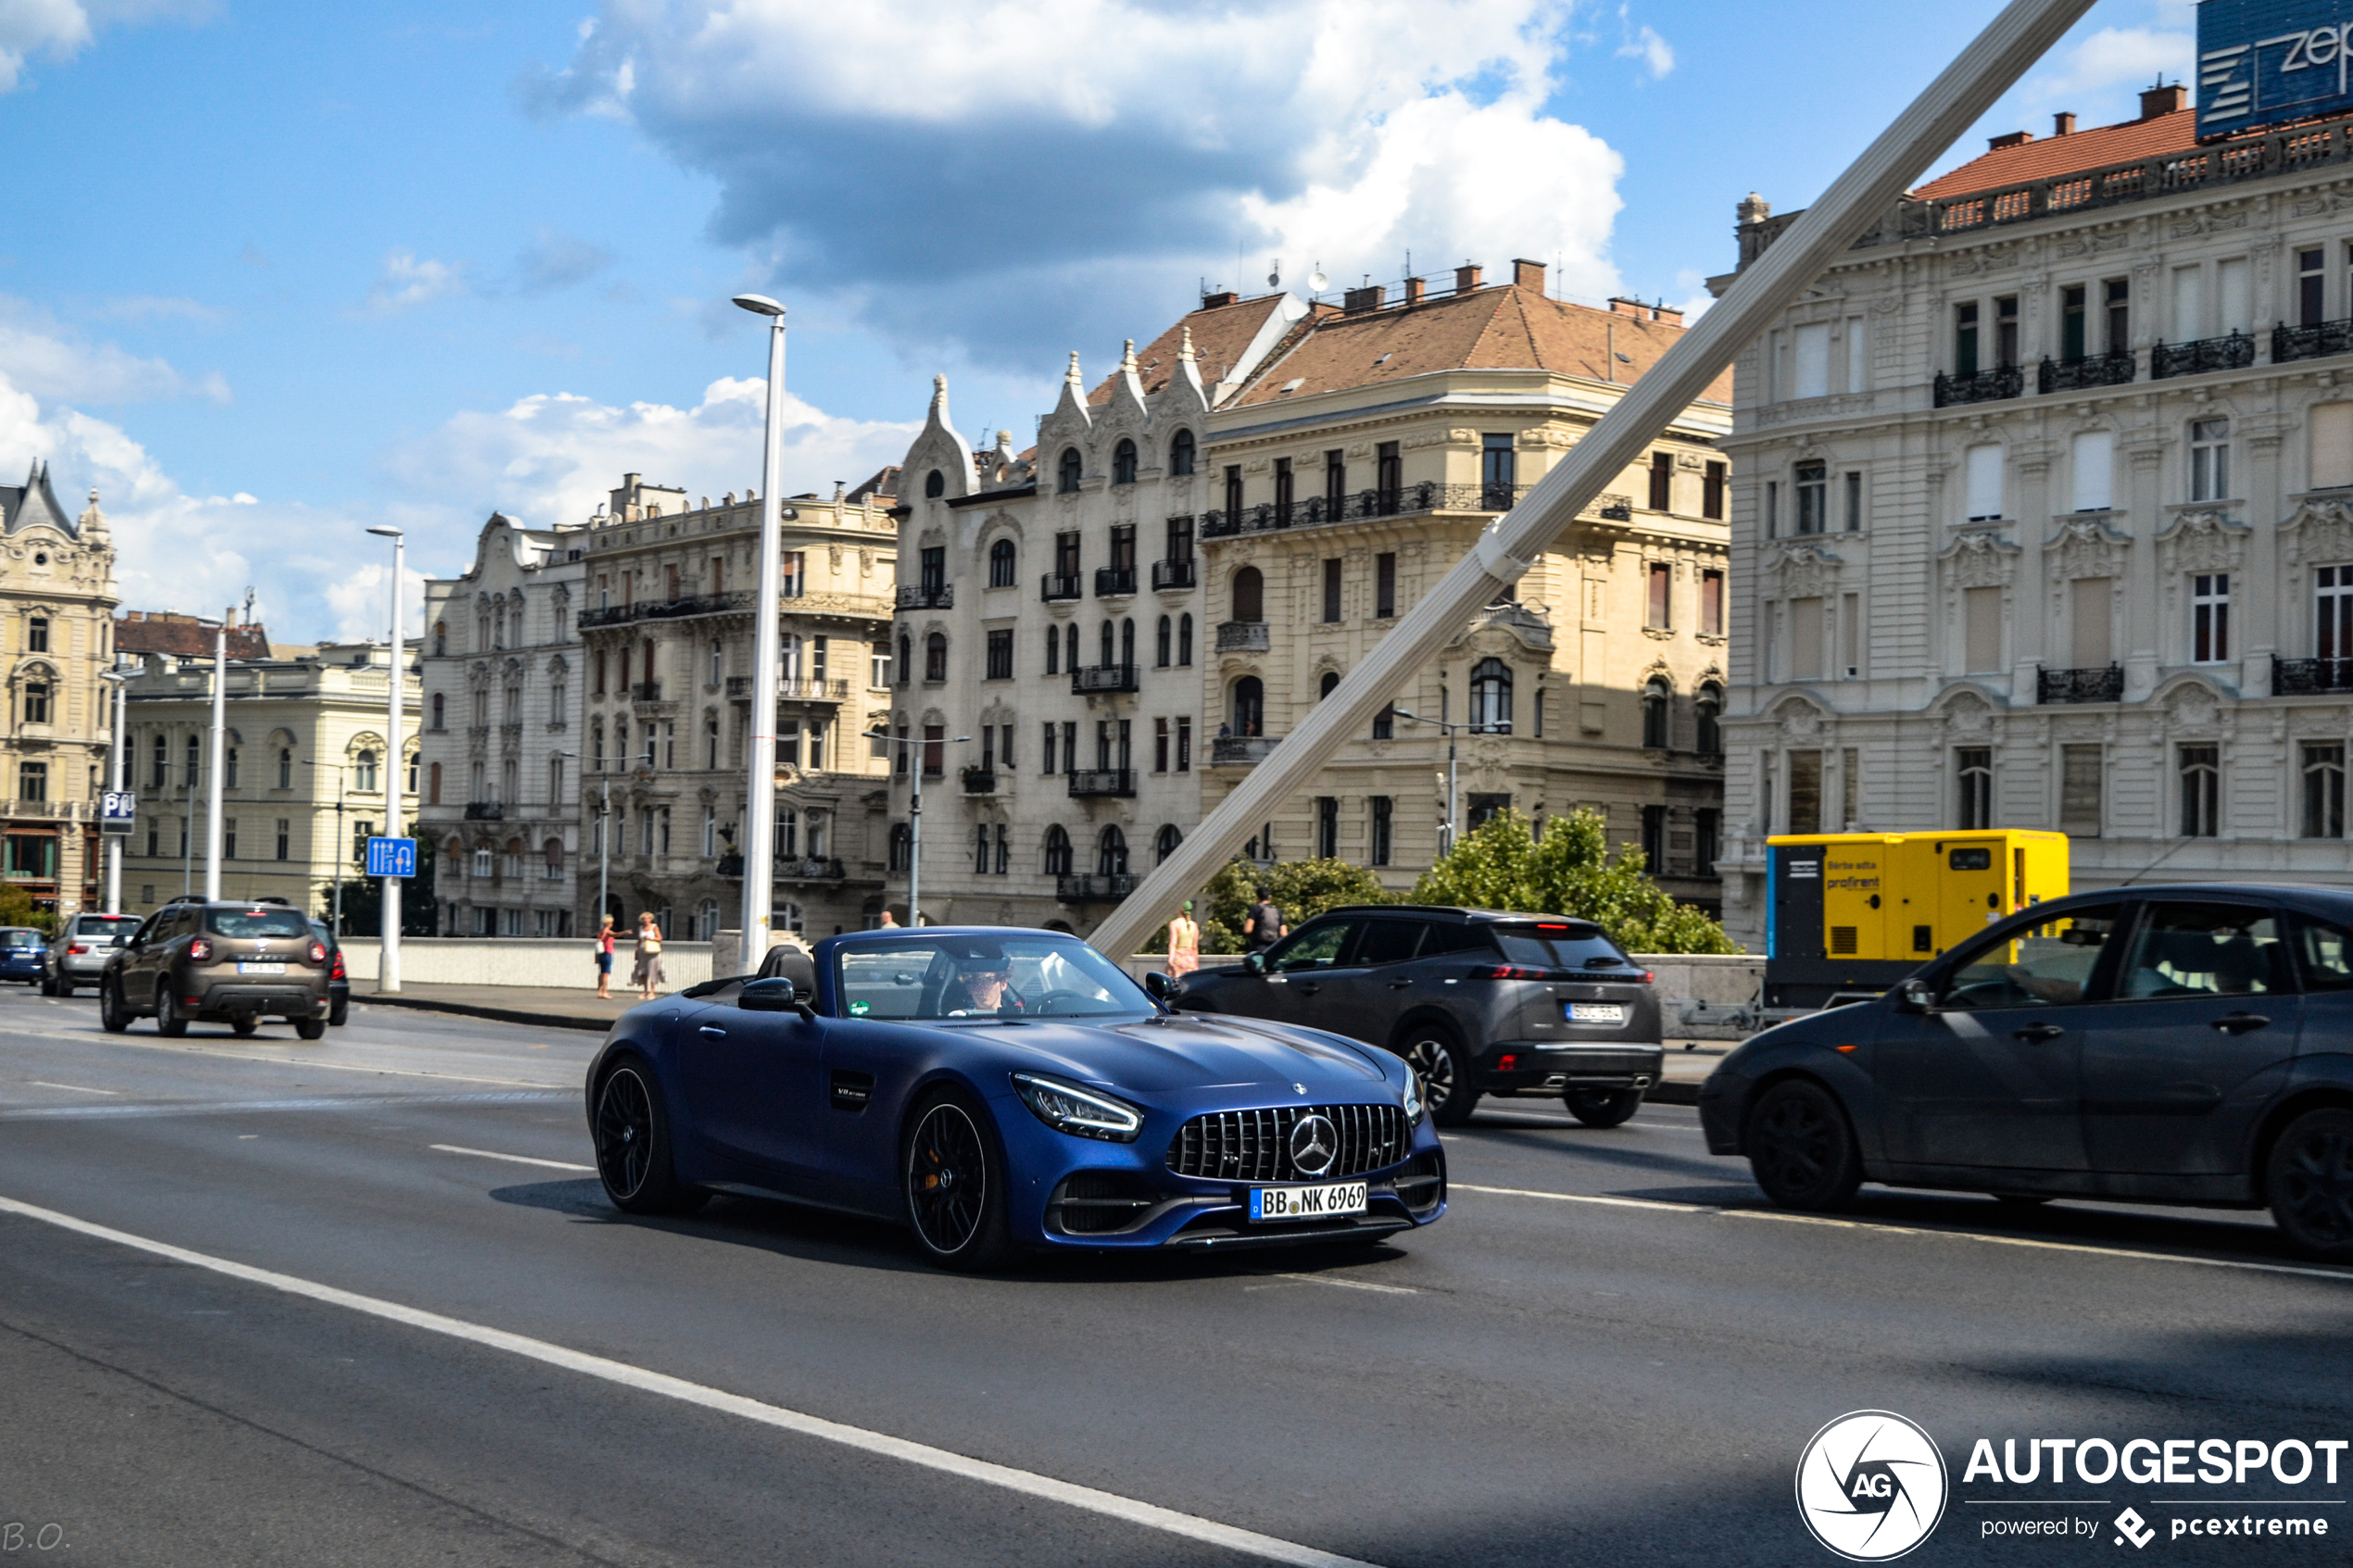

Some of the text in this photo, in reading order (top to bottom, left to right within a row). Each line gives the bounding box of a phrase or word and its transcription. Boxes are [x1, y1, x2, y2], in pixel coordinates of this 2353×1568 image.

[1264, 1191, 1287, 1214] BB
[1302, 1188, 1324, 1212] NK
[1327, 1185, 1365, 1210] 6969
